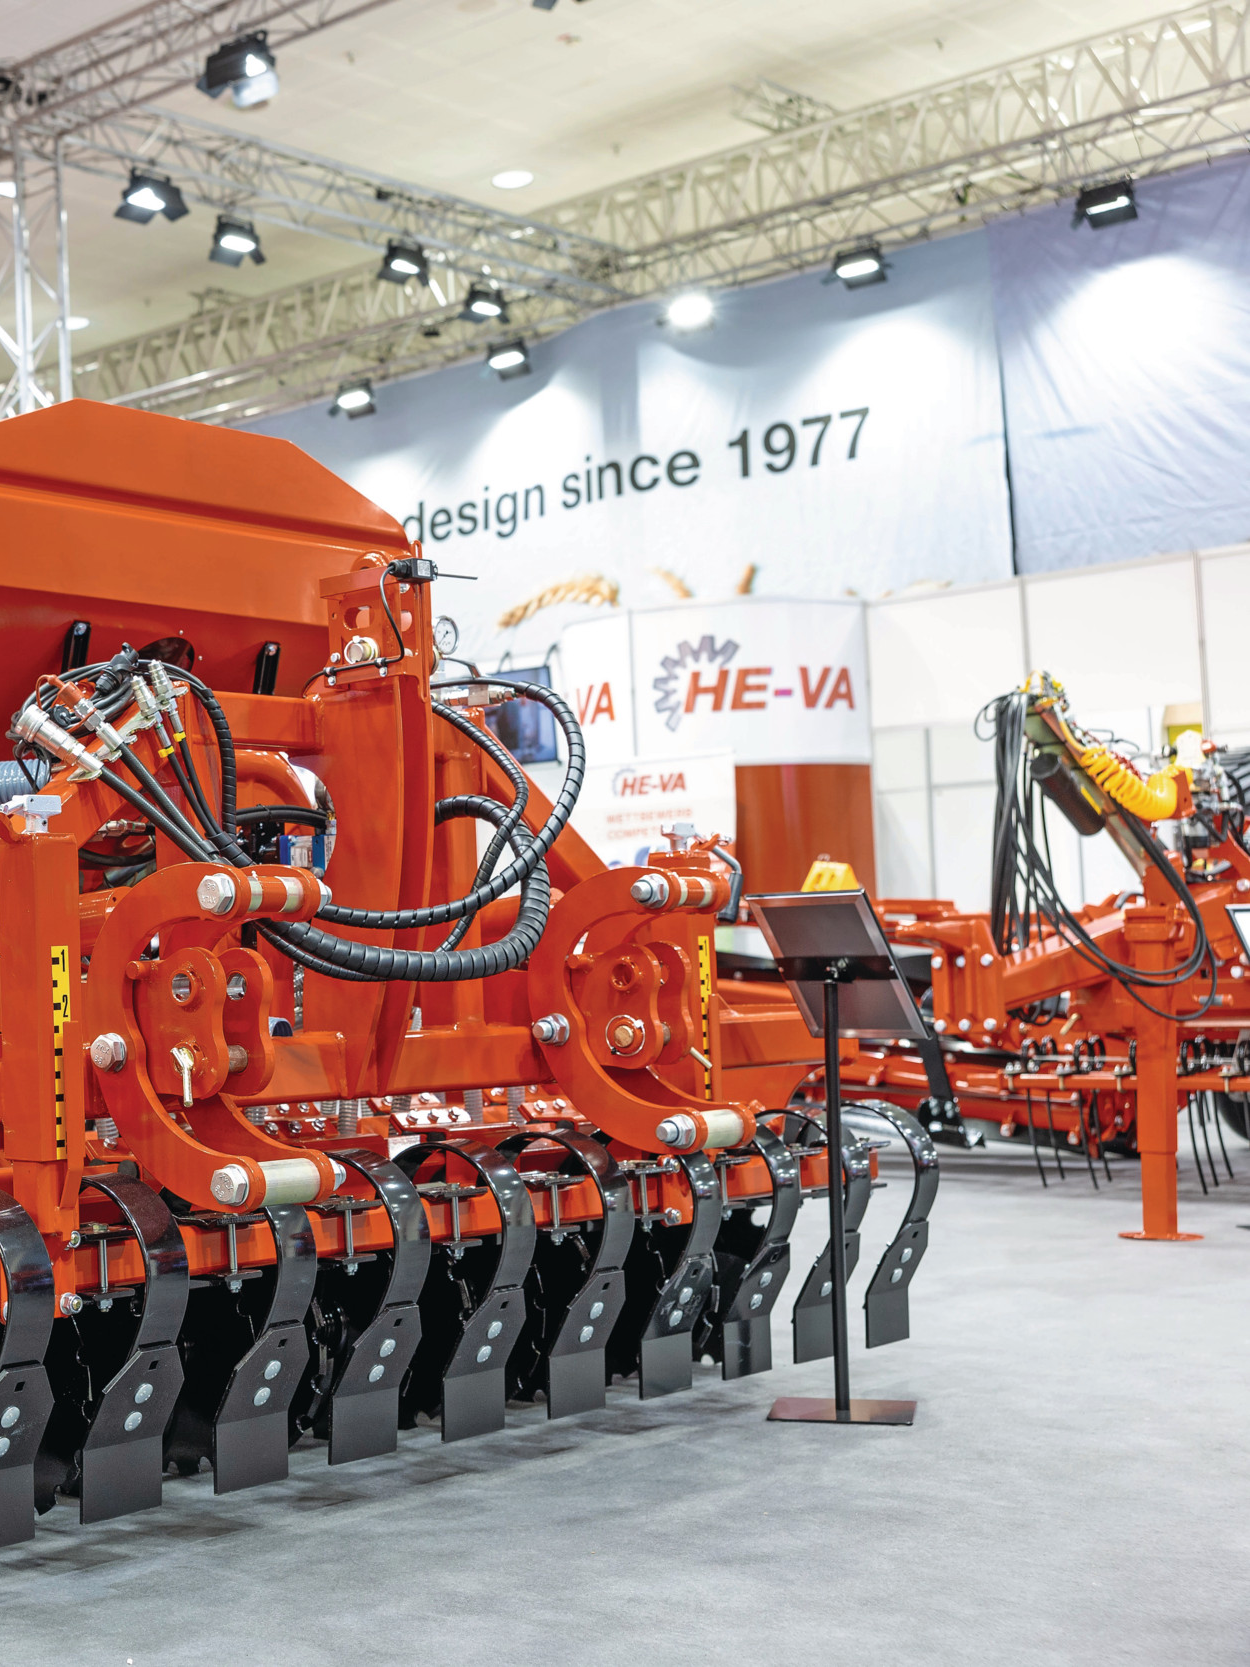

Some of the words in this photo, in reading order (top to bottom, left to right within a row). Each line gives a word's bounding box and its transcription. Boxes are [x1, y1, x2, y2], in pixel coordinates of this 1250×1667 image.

[403, 484, 545, 544] design
[562, 449, 700, 510] since
[727, 407, 870, 478] 1977
[683, 665, 857, 714] HE-VA
[620, 772, 687, 797] HE-VA
[61, 949, 65, 972] 1
[62, 994, 69, 1018] 2
